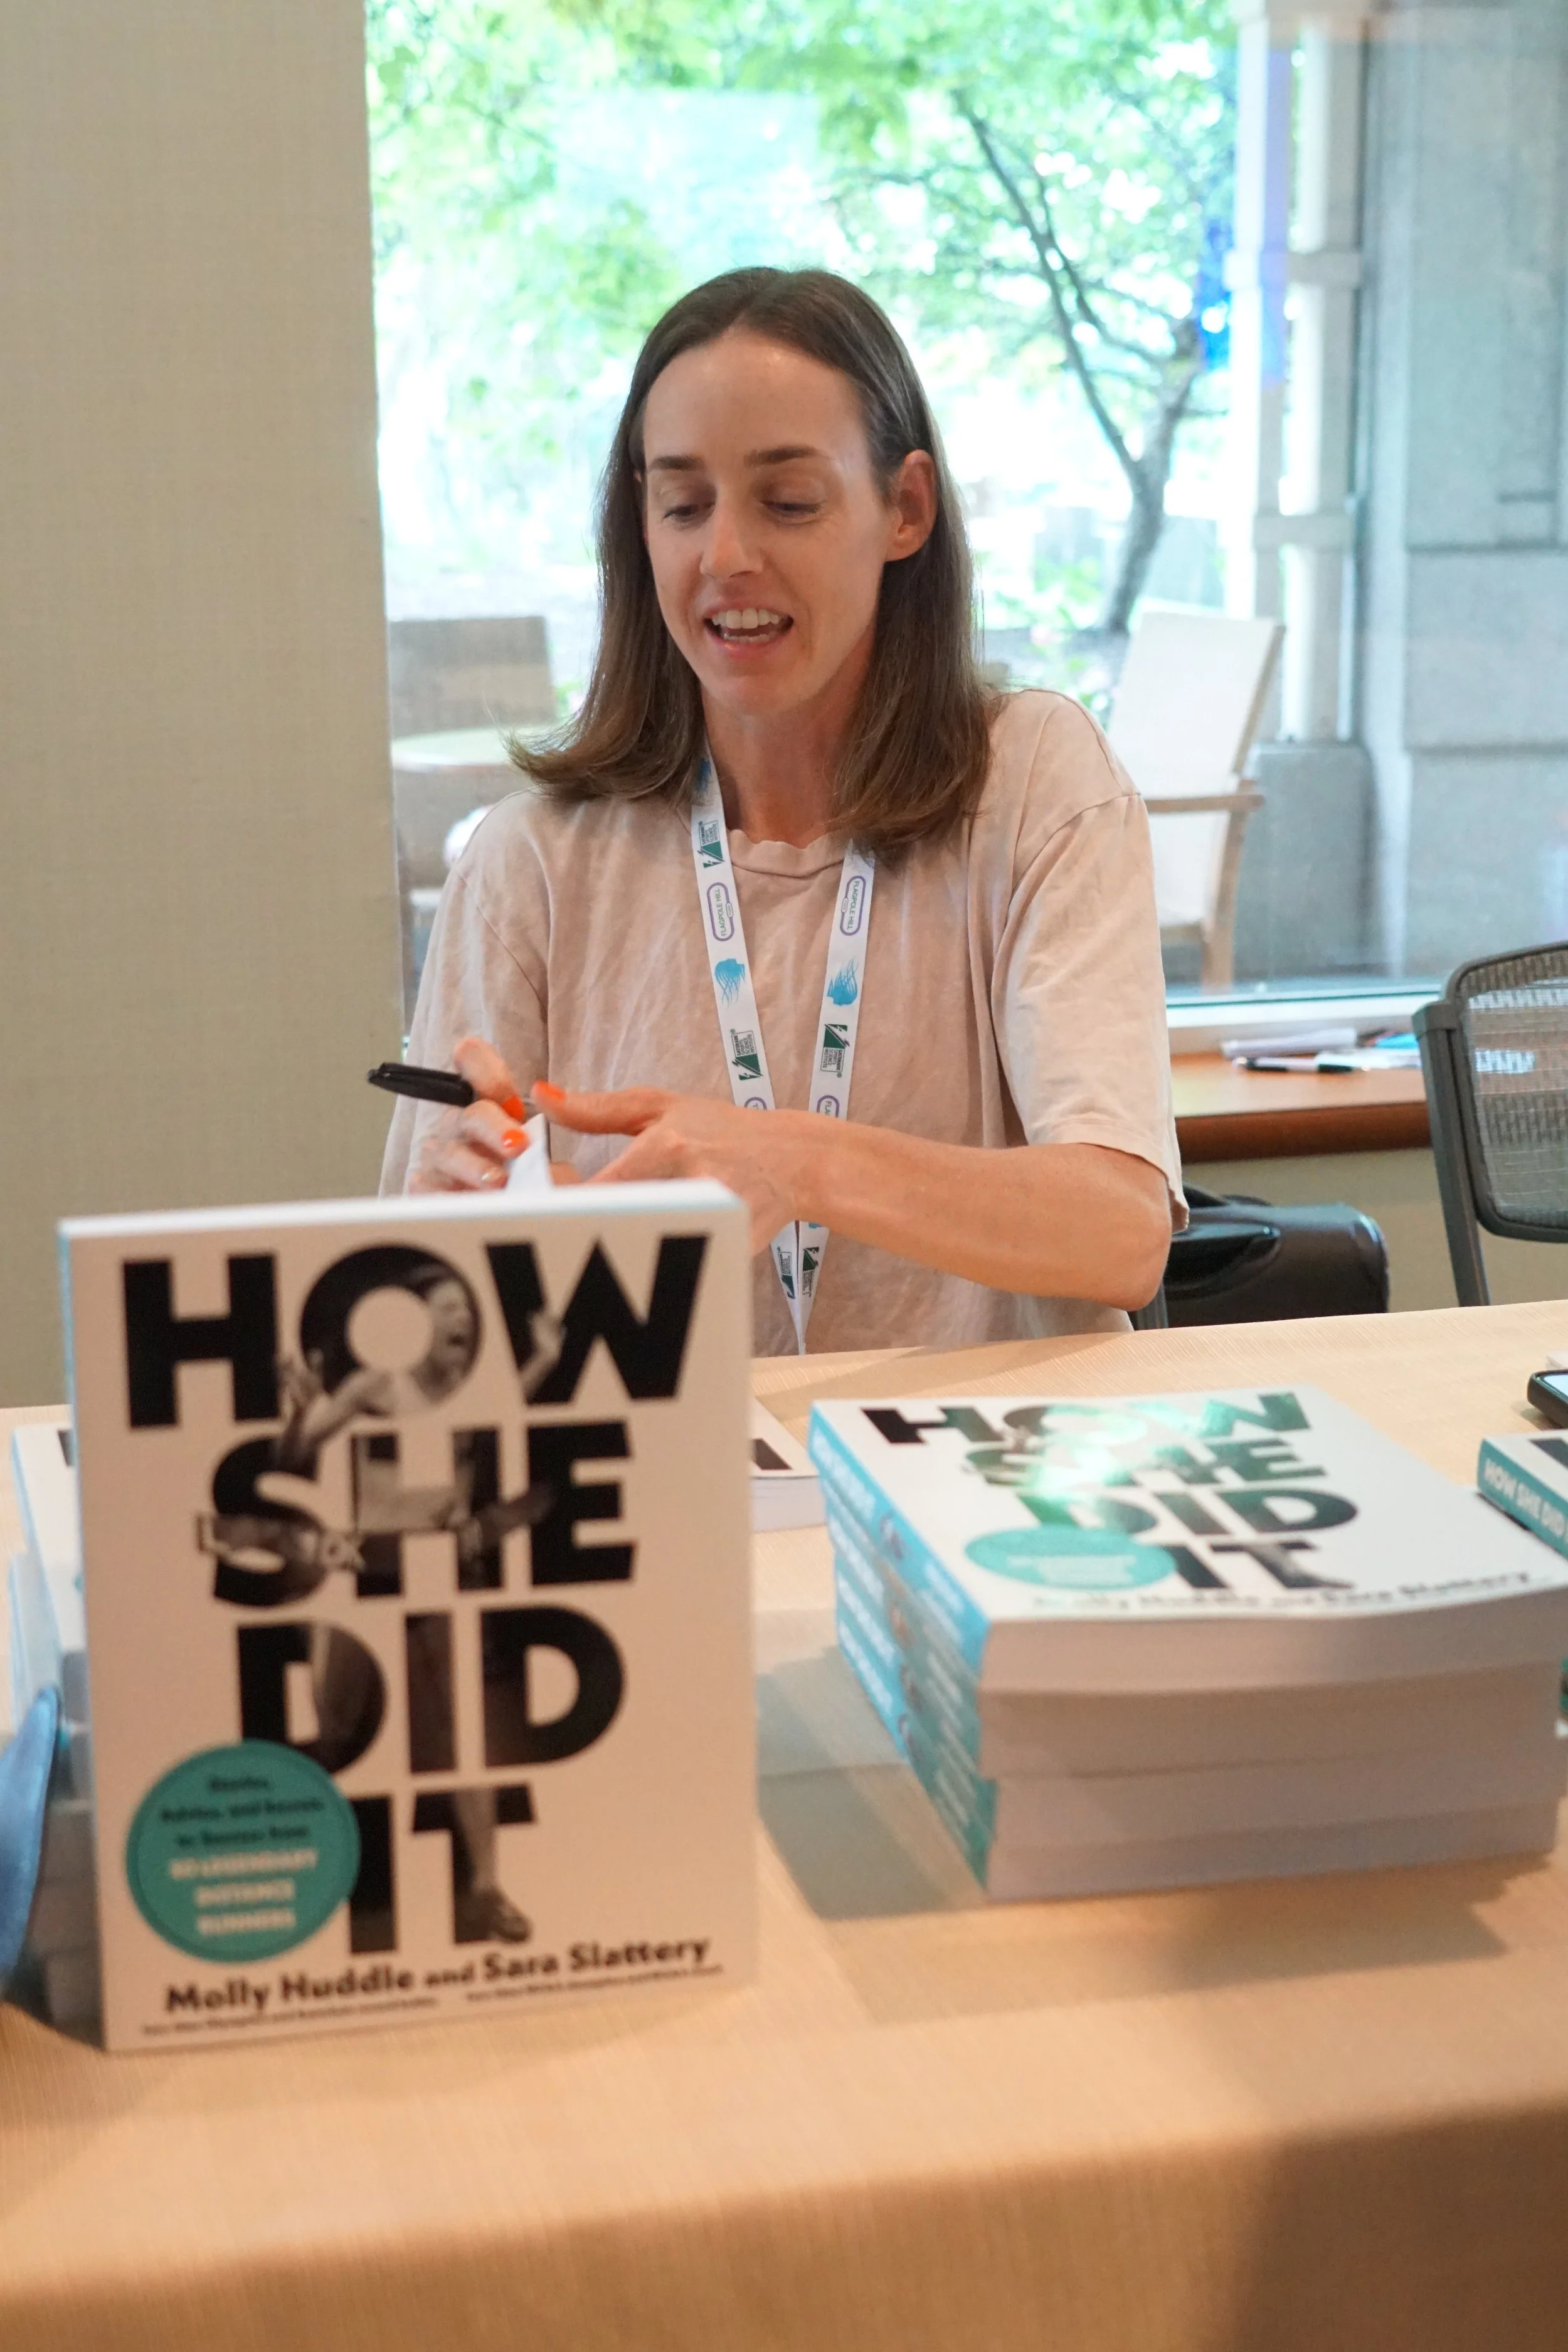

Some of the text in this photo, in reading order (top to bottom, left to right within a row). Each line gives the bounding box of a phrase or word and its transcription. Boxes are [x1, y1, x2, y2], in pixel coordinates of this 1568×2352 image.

[716, 903, 727, 936] FLAGPOLE
[849, 881, 859, 914] FLAGPOLE
[122, 1233, 710, 1428] HOW
[861, 1391, 1311, 1444] HOW
[211, 1419, 638, 1607] SHE
[1017, 1488, 1358, 1535] DID
[1483, 1458, 1566, 1539] HOW SHE DID
[1162, 1540, 1355, 1589] IT
[236, 1605, 627, 1776] DID
[348, 1783, 538, 1954] IT
[166, 1977, 269, 2013] Molly
[280, 1964, 413, 2001] Huddle
[424, 1961, 475, 1989] and
[483, 1951, 559, 1982] Sara
[569, 1937, 710, 1972] Slattery
